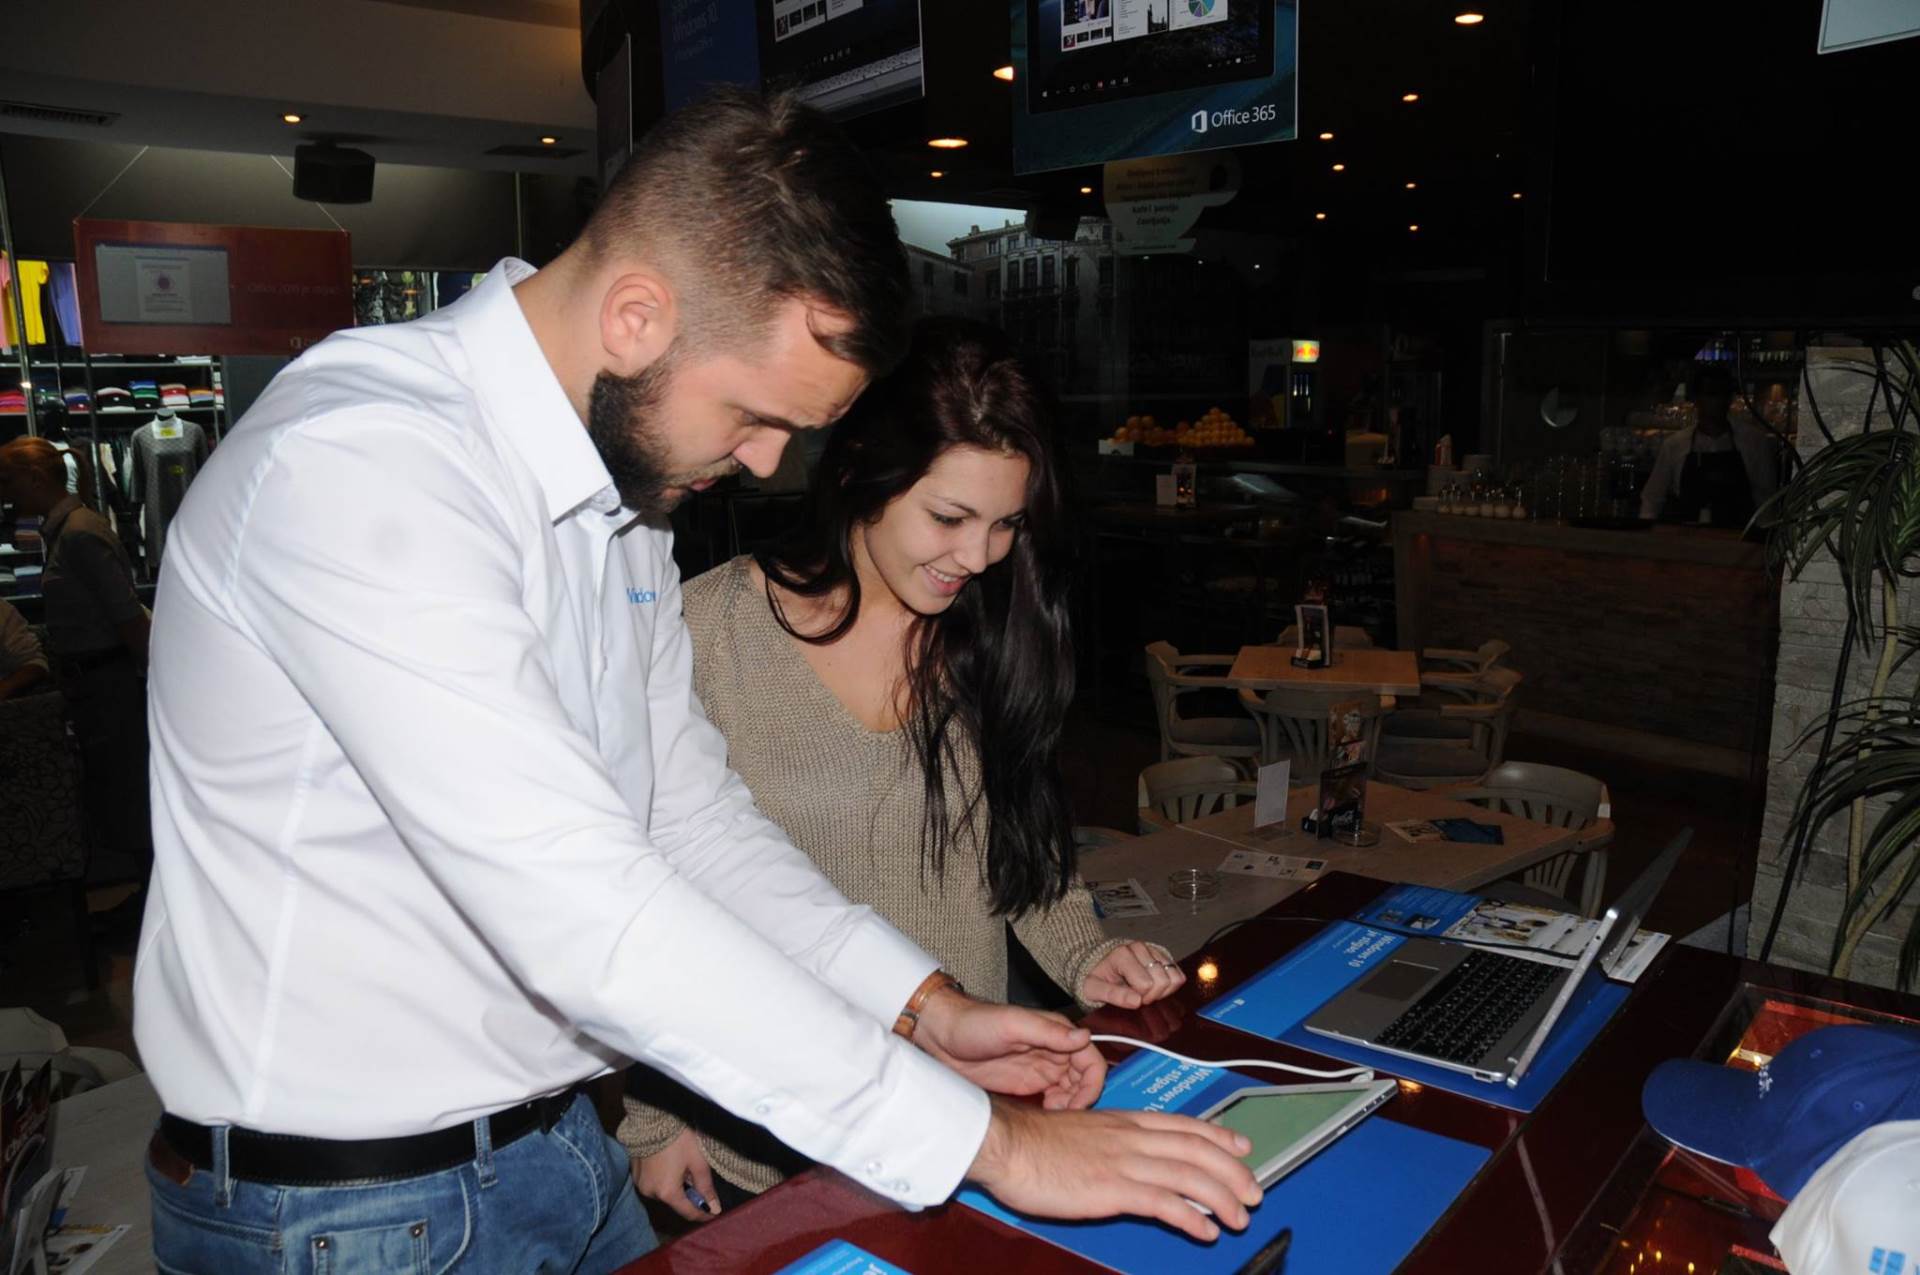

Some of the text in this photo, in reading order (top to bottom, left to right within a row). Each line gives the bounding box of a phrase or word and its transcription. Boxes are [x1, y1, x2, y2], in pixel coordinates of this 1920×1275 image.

[1211, 104, 1277, 128] Office 365
[1357, 934, 1396, 959] Windows
[1348, 958, 1365, 969] 10
[1141, 1069, 1182, 1095] stigao.
[1158, 1066, 1214, 1104] Windows
